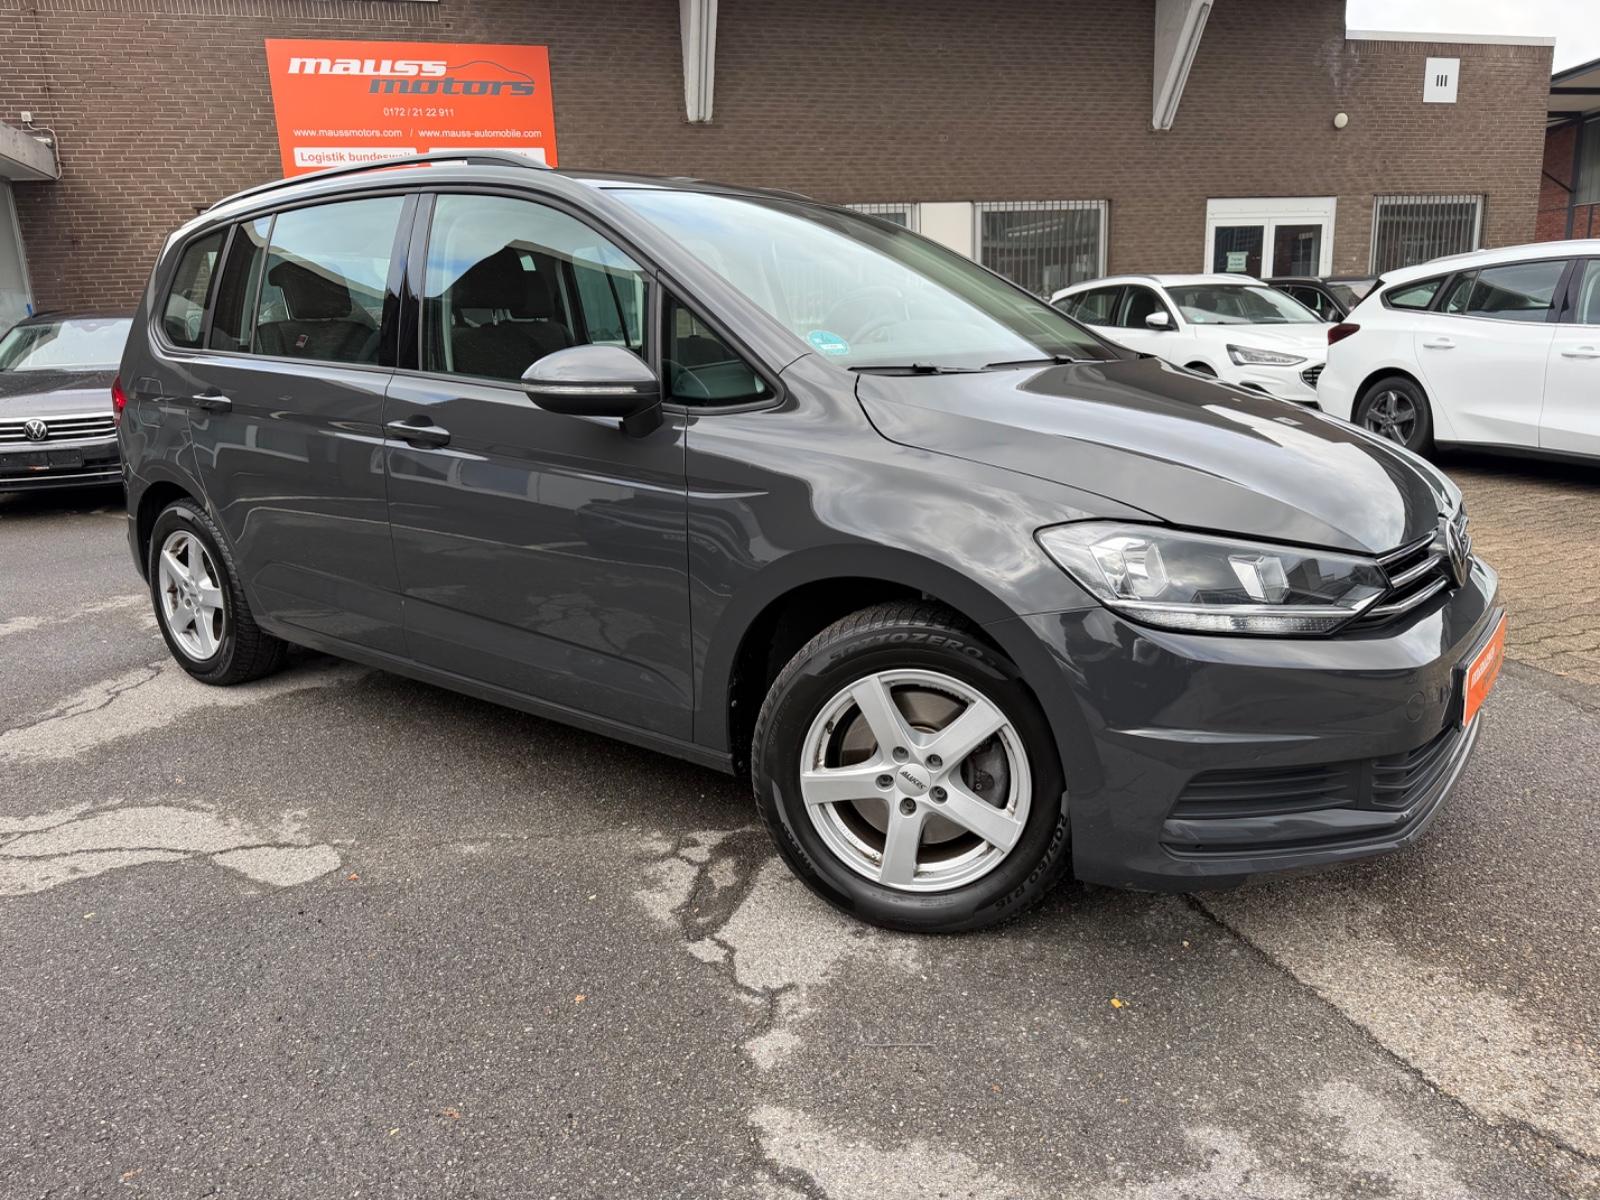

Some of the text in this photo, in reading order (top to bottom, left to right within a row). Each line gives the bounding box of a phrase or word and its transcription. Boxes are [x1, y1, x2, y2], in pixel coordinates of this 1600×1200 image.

[288, 57, 447, 76] mauss
[369, 77, 535, 96] motors
[383, 108, 405, 118] 0172
[412, 108, 423, 118] 21
[425, 108, 437, 118] 22
[439, 108, 455, 118] 911
[293, 128, 402, 138] www.maussmotors.com
[418, 129, 542, 139] www.mauss-automobile.com
[300, 151, 345, 163] Logistik
